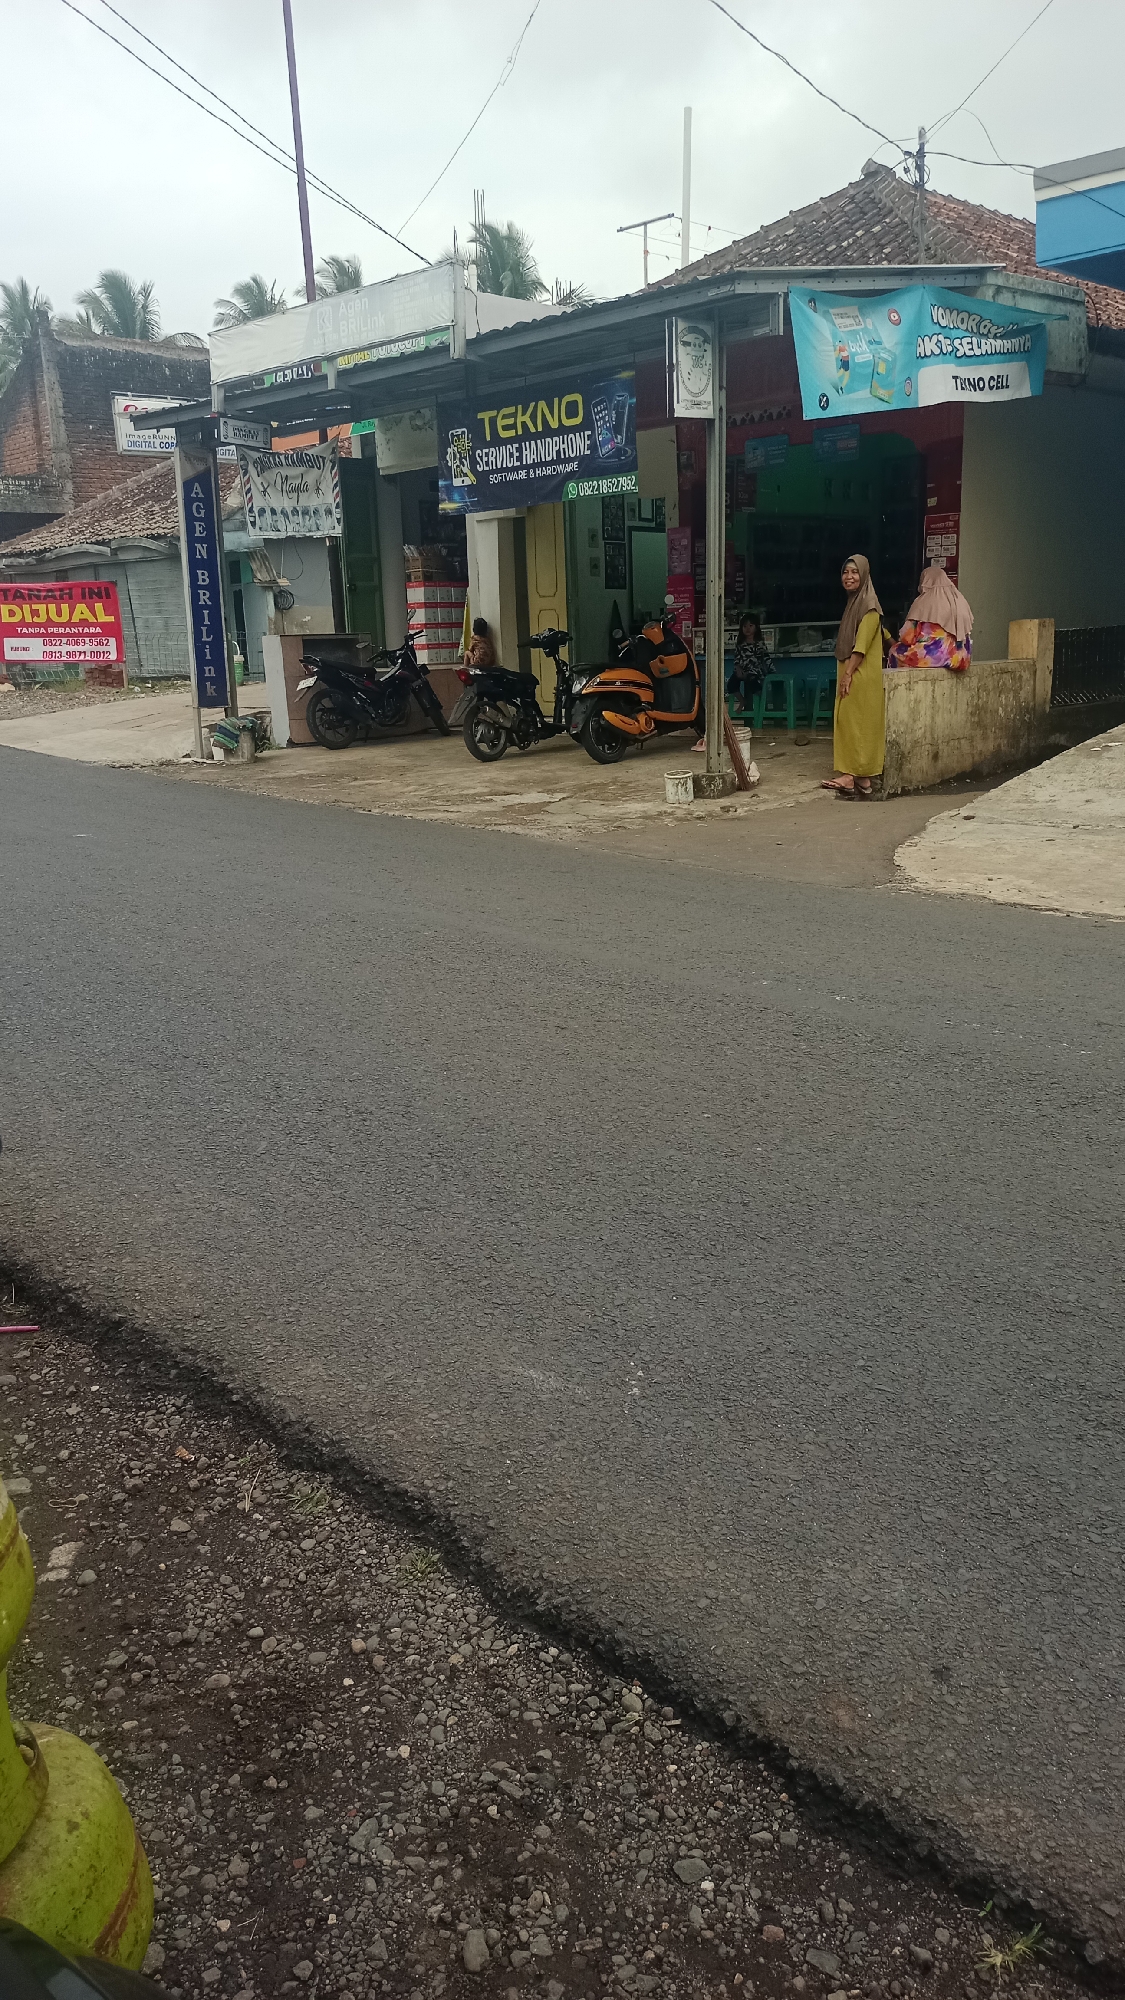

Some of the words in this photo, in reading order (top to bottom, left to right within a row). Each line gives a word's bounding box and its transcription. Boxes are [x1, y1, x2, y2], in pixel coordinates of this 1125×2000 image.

[953, 334, 1032, 358] SELAMANYA
[987, 374, 1010, 391] CELL
[477, 393, 584, 442] TEKNO
[127, 440, 157, 449] DIGITAL
[475, 443, 521, 473] SERVICE
[522, 430, 592, 466] HANDPHONE
[283, 452, 327, 471] RAMBUT
[489, 472, 528, 484] SOFTWARE
[529, 469, 535, 478] &
[535, 461, 579, 478] HARDWARE
[578, 475, 637, 497] 082218527952
[190, 482, 208, 559] AGEN
[0, 587, 74, 601] TANAH
[81, 586, 112, 600] INI
[0, 602, 115, 623] DIJUAL
[47, 626, 103, 634] PERANTARA
[196, 569, 218, 697] BRILink
